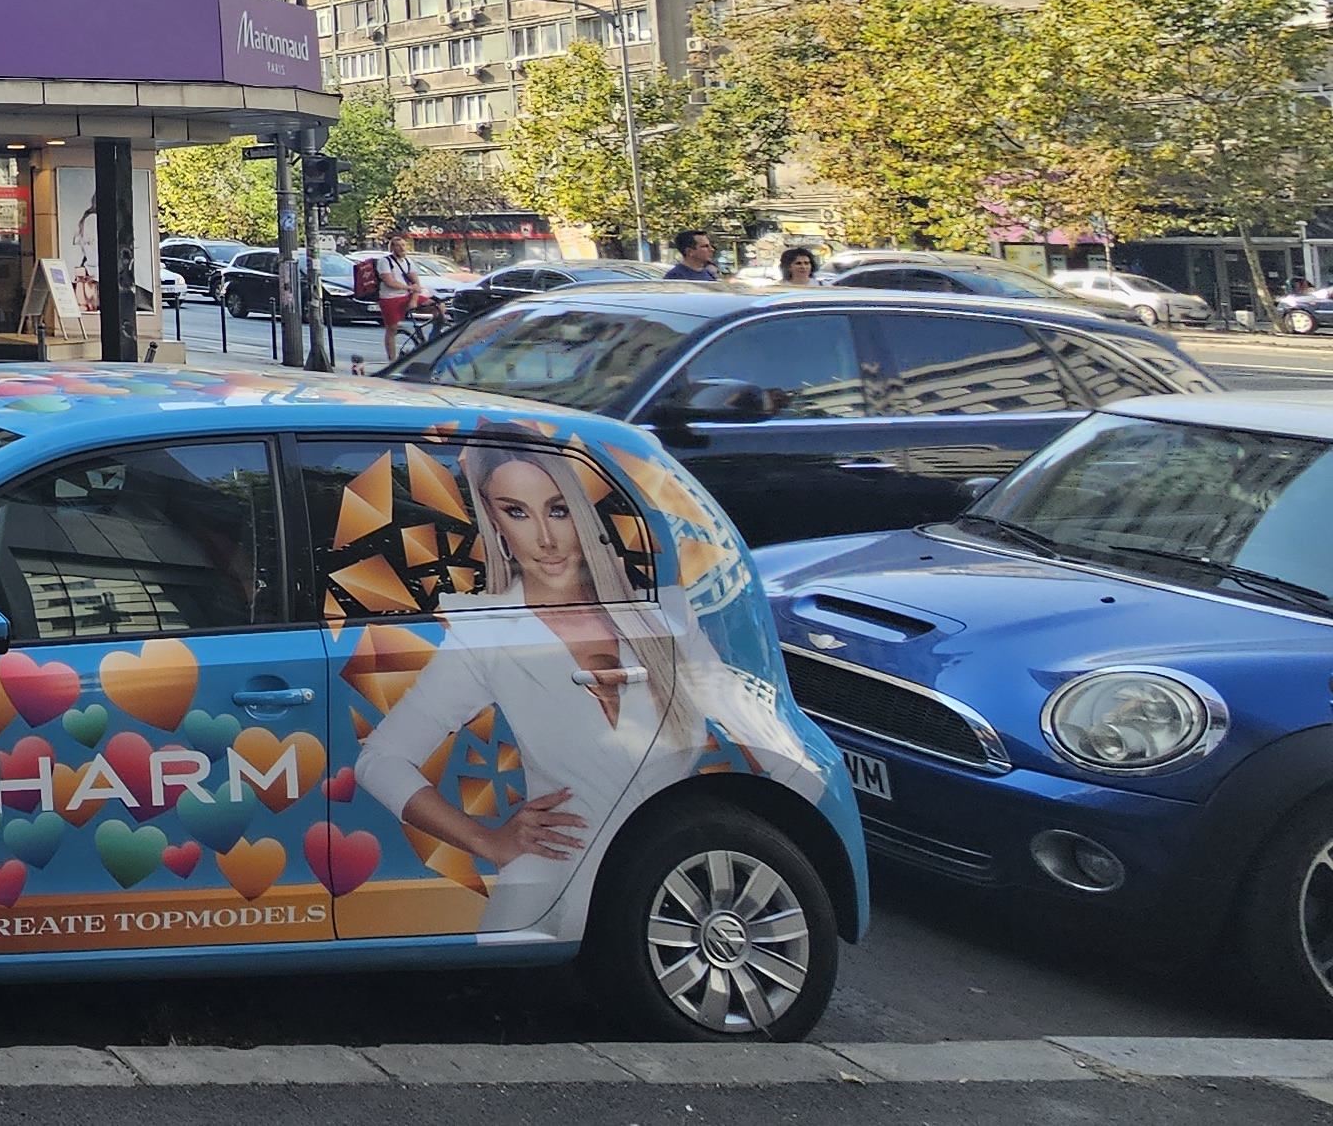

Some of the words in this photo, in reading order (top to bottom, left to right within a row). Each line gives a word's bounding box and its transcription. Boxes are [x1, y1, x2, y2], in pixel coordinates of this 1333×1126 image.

[237, 10, 309, 61] Marionnaud
[267, 61, 285, 76] PARIS
[114, 904, 327, 933] TOPMODELS
